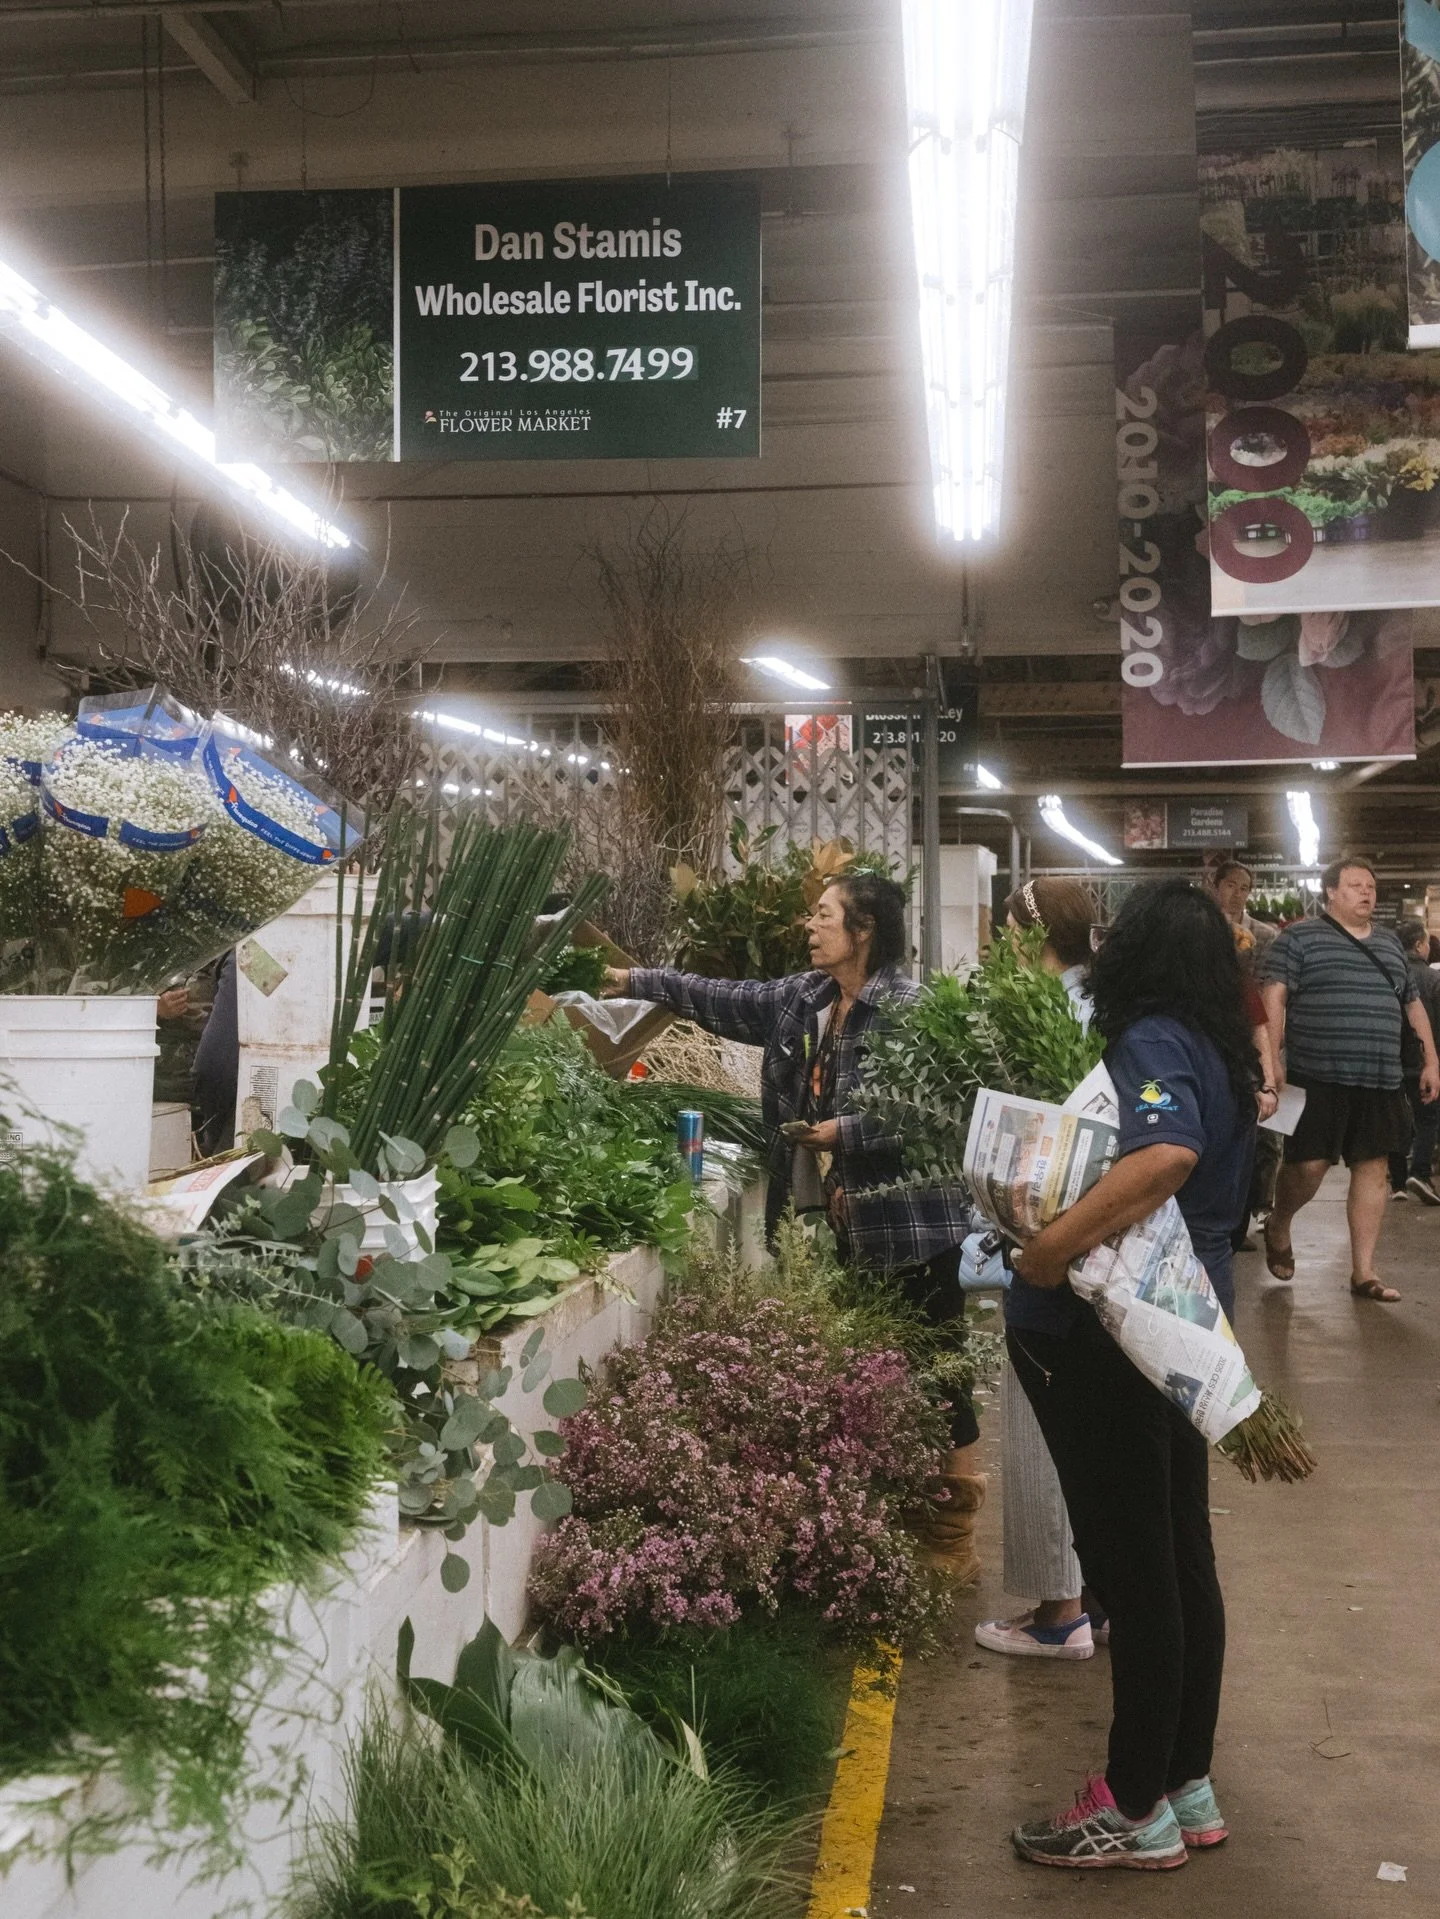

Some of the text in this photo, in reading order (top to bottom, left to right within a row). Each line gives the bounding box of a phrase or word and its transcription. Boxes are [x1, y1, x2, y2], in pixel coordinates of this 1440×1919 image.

[475, 217, 683, 261] Dan Stamis
[415, 280, 742, 317] Wholesale Florist Inc.
[459, 347, 694, 383] 213.988.7499
[440, 416, 592, 433] FLOWER MARKET
[466, 409, 513, 419] Original
[545, 408, 591, 418] Angeles
[716, 407, 747, 430] #7
[1116, 386, 1164, 689] 2010-2020
[1208, 1373, 1220, 1389] CES
